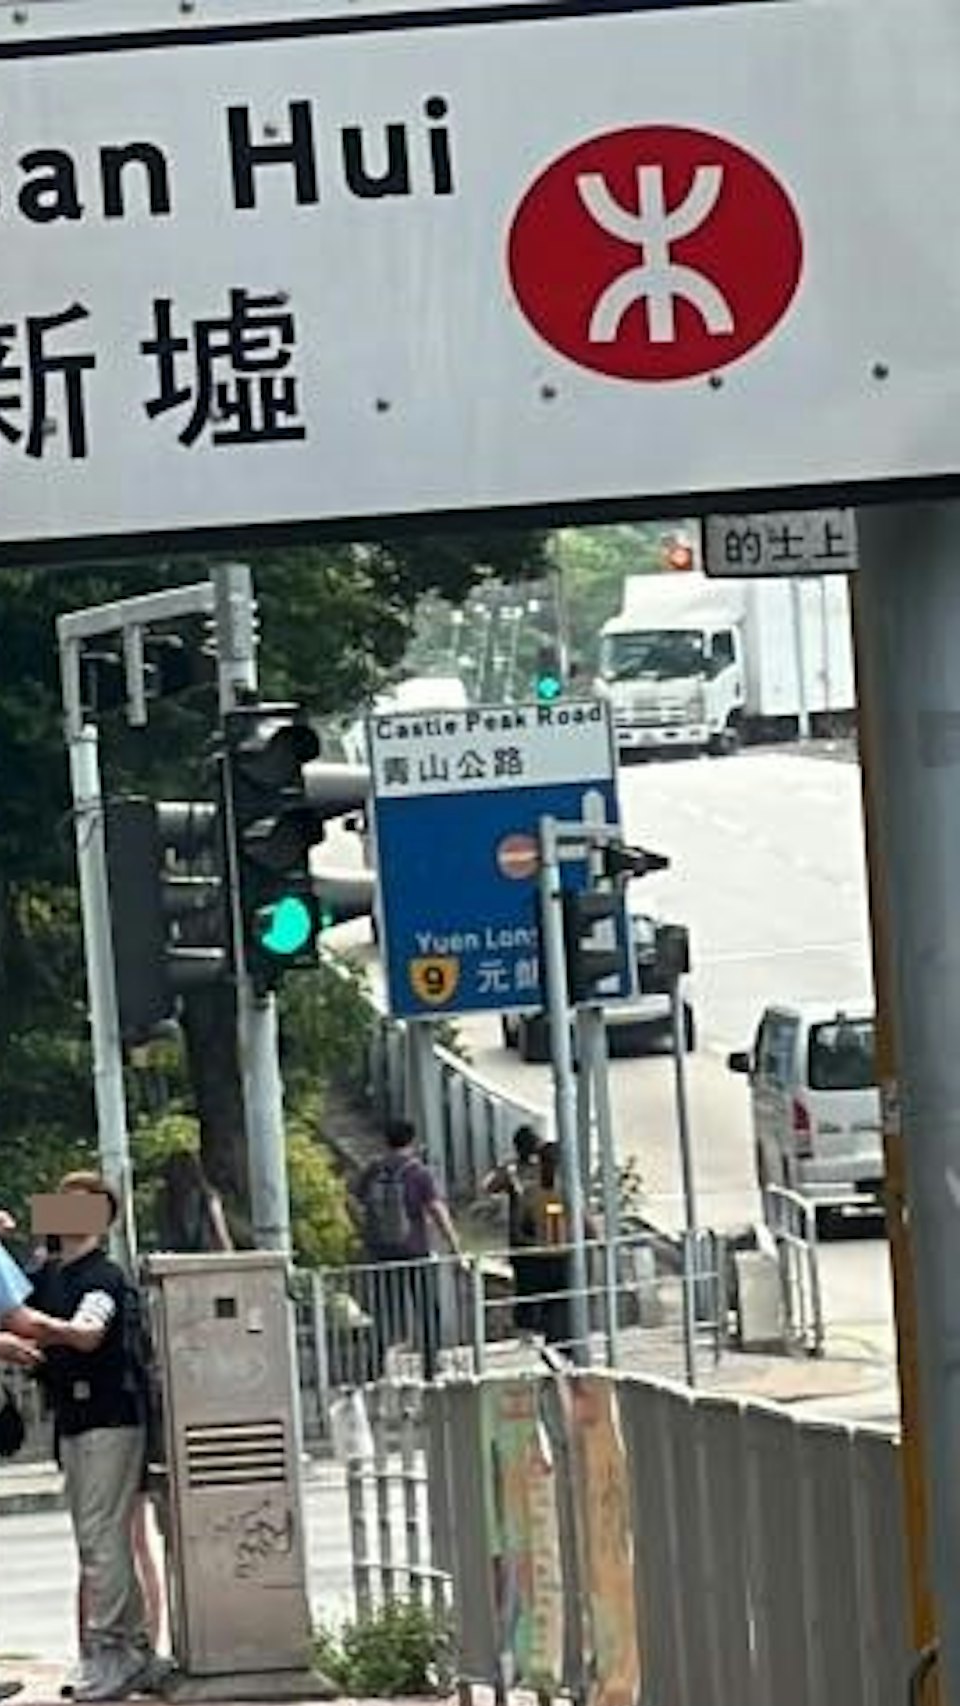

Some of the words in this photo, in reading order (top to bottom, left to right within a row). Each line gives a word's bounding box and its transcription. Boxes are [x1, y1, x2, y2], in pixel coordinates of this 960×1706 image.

[226, 96, 454, 210] Hui
[376, 717, 458, 739] Castle
[466, 711, 527, 733] Peak
[537, 705, 602, 727] Road
[383, 747, 524, 786] 青山公路
[415, 930, 480, 954] Yuen
[424, 966, 444, 995] 9
